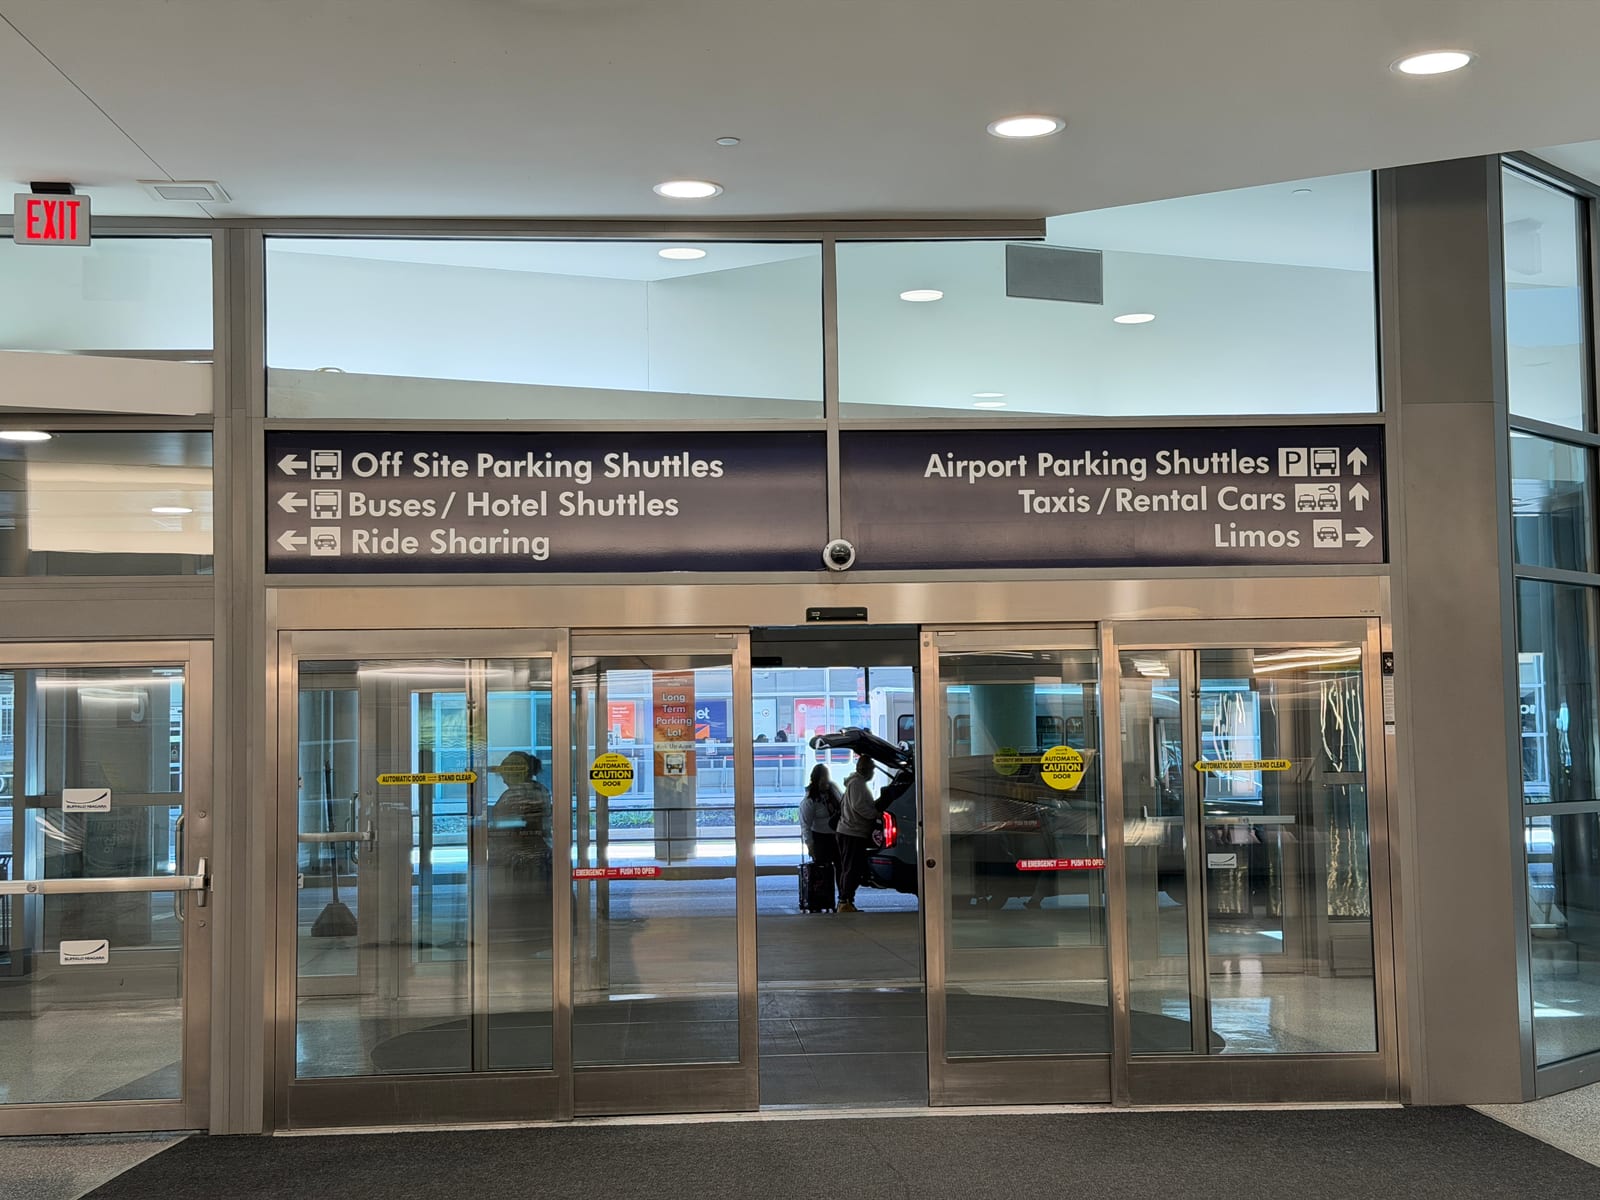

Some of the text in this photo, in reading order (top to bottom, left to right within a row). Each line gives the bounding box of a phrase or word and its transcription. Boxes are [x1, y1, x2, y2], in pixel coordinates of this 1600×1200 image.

[27, 199, 80, 240] EXIT
[352, 451, 724, 484] Off Site Parking Shuttles
[924, 449, 1270, 484] Airport Parking Shuttles
[1285, 451, 1302, 474] P
[467, 490, 547, 516] Hotel
[559, 490, 679, 516] Shuttles
[1018, 487, 1091, 514] Taxis
[1115, 486, 1207, 512] Rental
[1217, 486, 1286, 511] Cars
[1214, 522, 1301, 548] Limos
[352, 528, 550, 561] Ride Sharing
[662, 692, 686, 703] Long
[662, 704, 686, 713] Term
[695, 707, 710, 719] et
[656, 716, 692, 726] Parking
[667, 728, 682, 737] Lot
[1042, 763, 1081, 772] CAUTION
[382, 775, 411, 783] AUTOMATIC
[412, 774, 426, 782] DOOR
[438, 774, 455, 782] STAND
[592, 770, 632, 779] CAUTION
[1070, 859, 1085, 867] PUSH
[575, 868, 606, 877] EMERGENCY
[619, 867, 634, 876] PUSH
[634, 867, 641, 875] TO
[641, 867, 656, 875] OPEN
